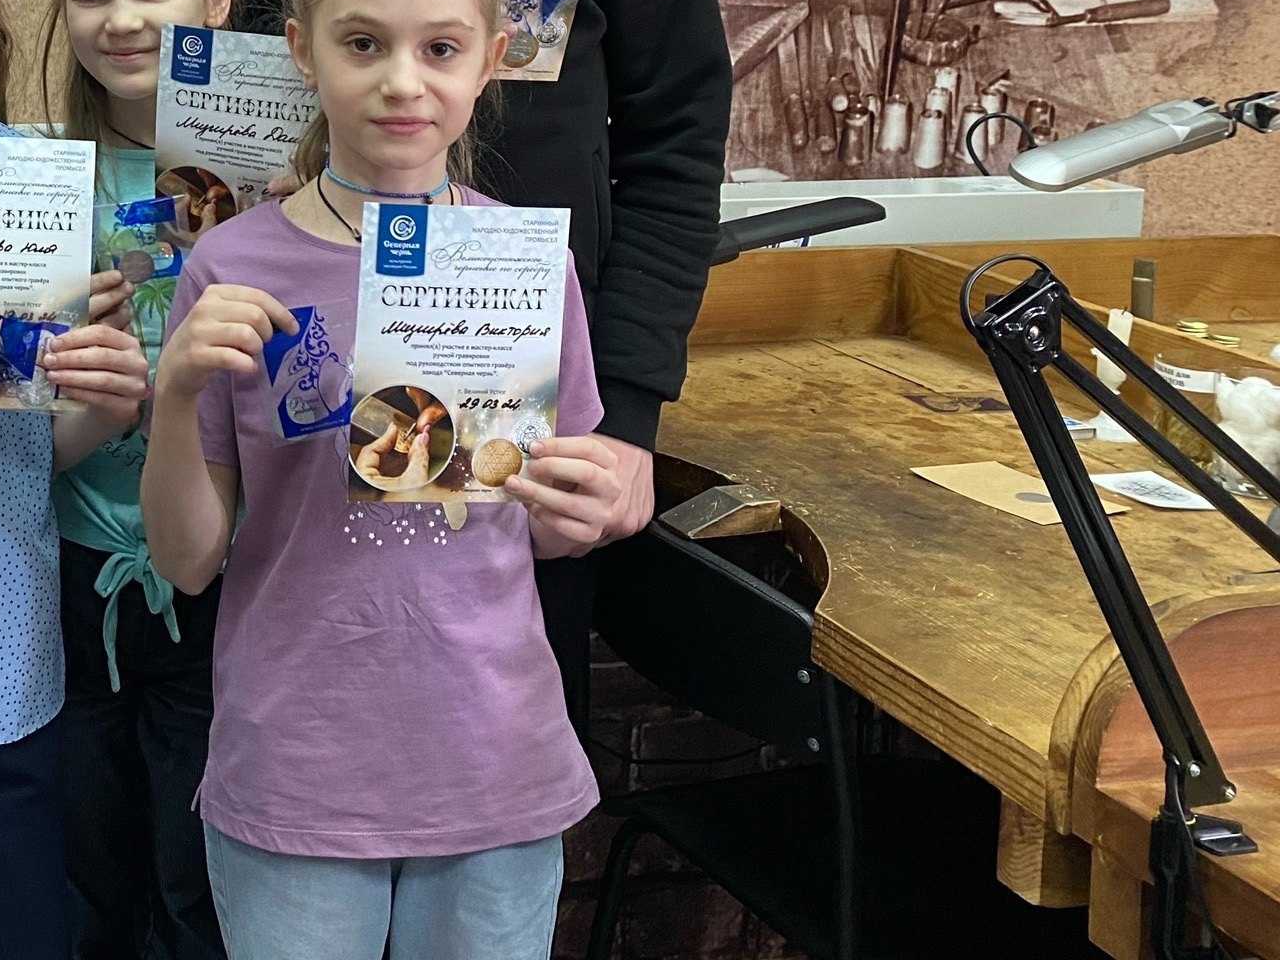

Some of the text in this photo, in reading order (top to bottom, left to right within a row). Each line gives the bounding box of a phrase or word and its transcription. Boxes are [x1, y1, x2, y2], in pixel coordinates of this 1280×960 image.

[176, 89, 315, 123] СЕРТИФИКАТ
[381, 284, 548, 310] СЕРТИФИКАТ
[475, 323, 551, 343] Виктория
[459, 397, 480, 410] 29
[482, 398, 499, 410] 03
